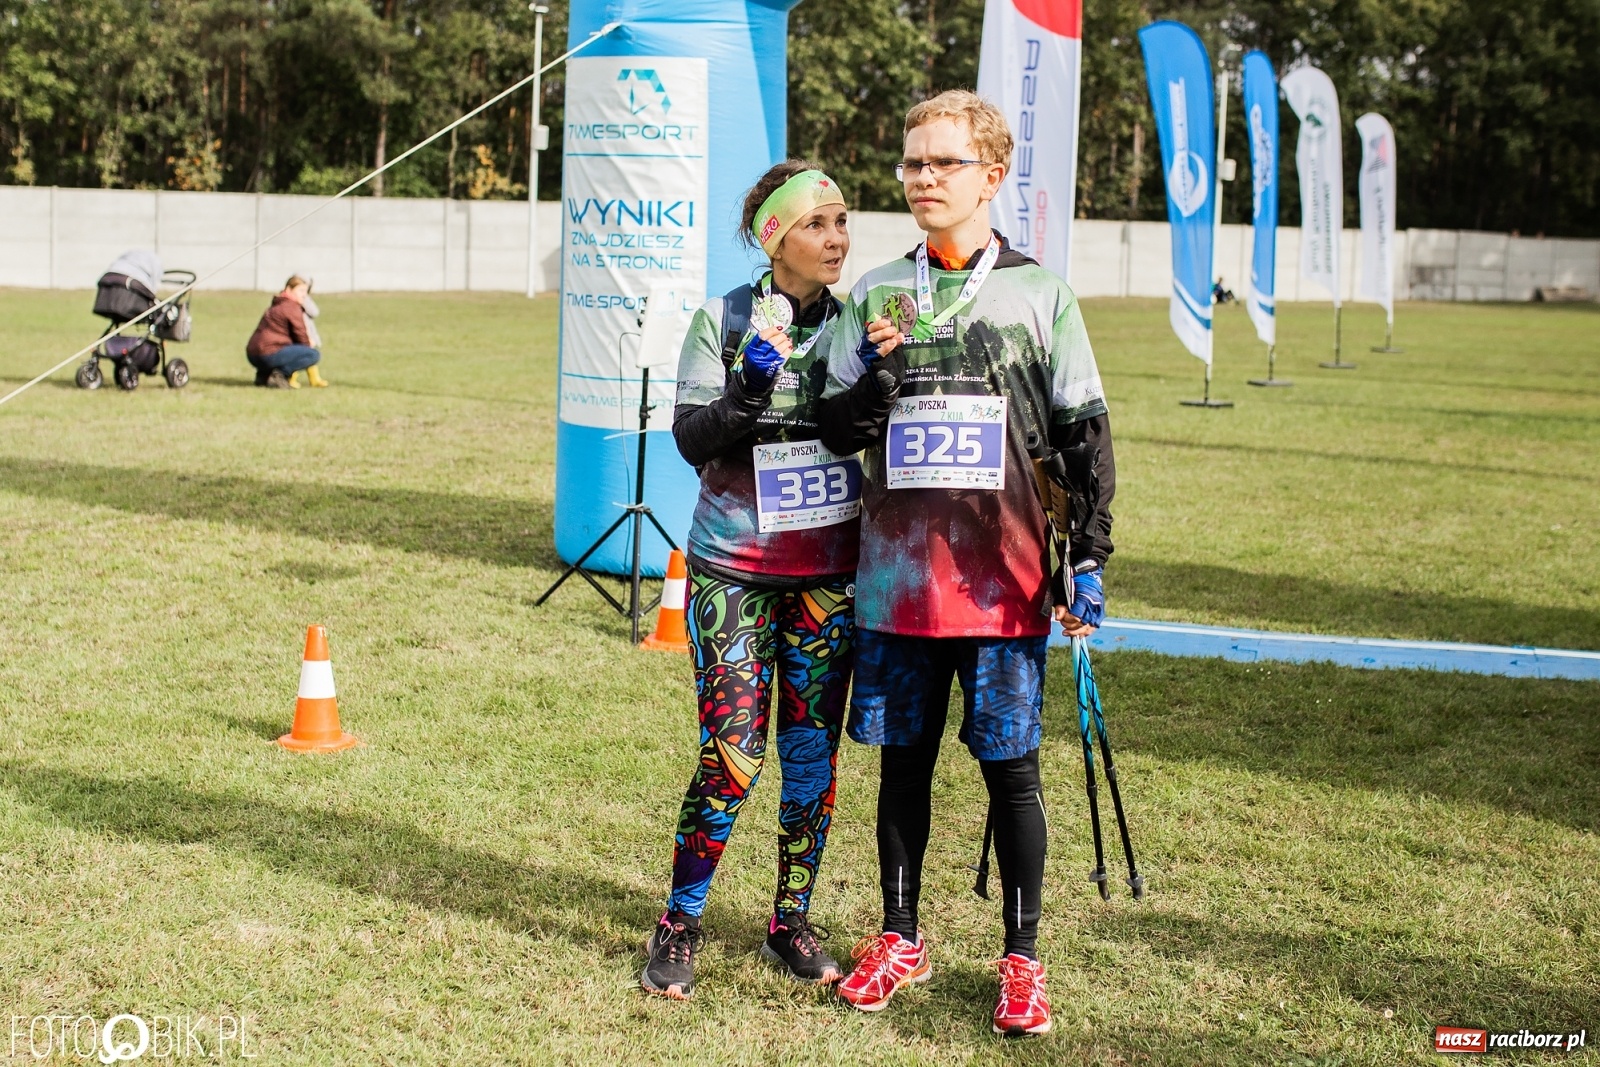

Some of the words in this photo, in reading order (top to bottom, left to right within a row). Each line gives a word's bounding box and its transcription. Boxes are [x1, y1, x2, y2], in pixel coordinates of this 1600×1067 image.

[569, 124, 698, 140] TIMESPORT
[567, 198, 694, 227] WYNIKI
[571, 231, 685, 249] ZNAJDZIESZ
[572, 253, 591, 267] NA
[595, 254, 682, 270] STRONIE
[918, 400, 947, 410] DYSZKA
[940, 411, 946, 421] Z
[947, 411, 964, 422] KIJA
[791, 445, 818, 457] DYSZKA
[903, 425, 983, 464] 325
[813, 455, 818, 464] Z
[818, 454, 832, 464] KIJA
[777, 466, 849, 508] 333
